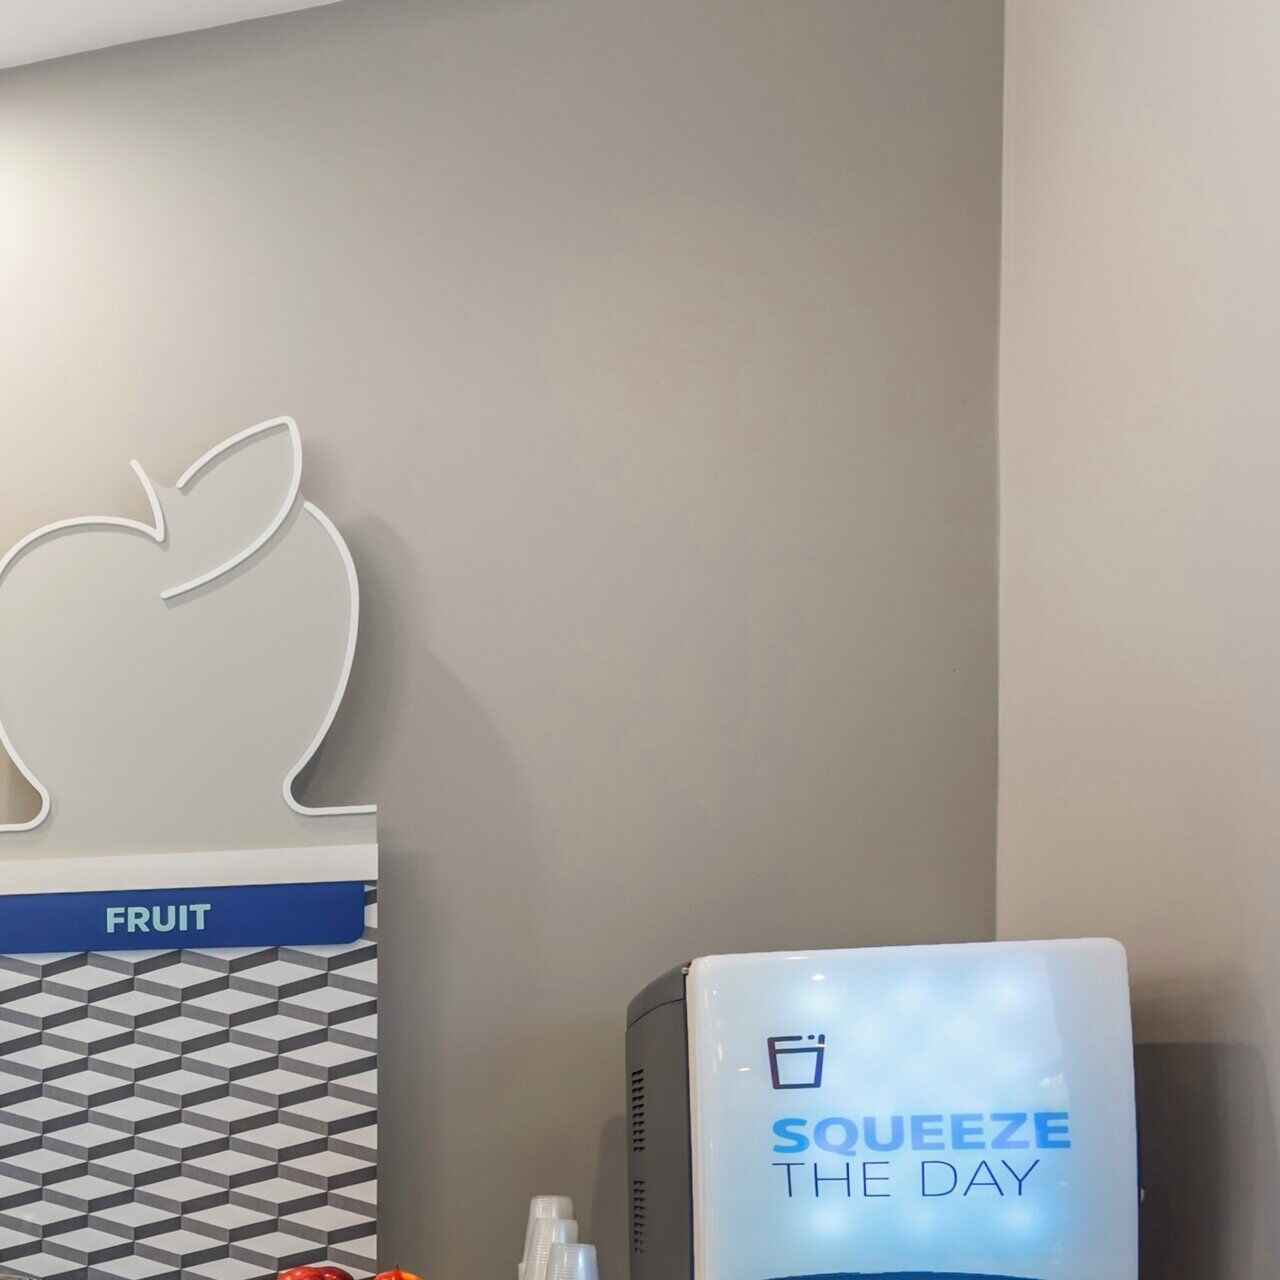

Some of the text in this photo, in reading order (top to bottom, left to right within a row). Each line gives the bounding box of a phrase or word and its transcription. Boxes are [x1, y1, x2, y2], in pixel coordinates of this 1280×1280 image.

[105, 902, 212, 934] FRUIT
[771, 1111, 1072, 1157] SQUEEZE
[771, 1158, 1041, 1198] THE DAY
